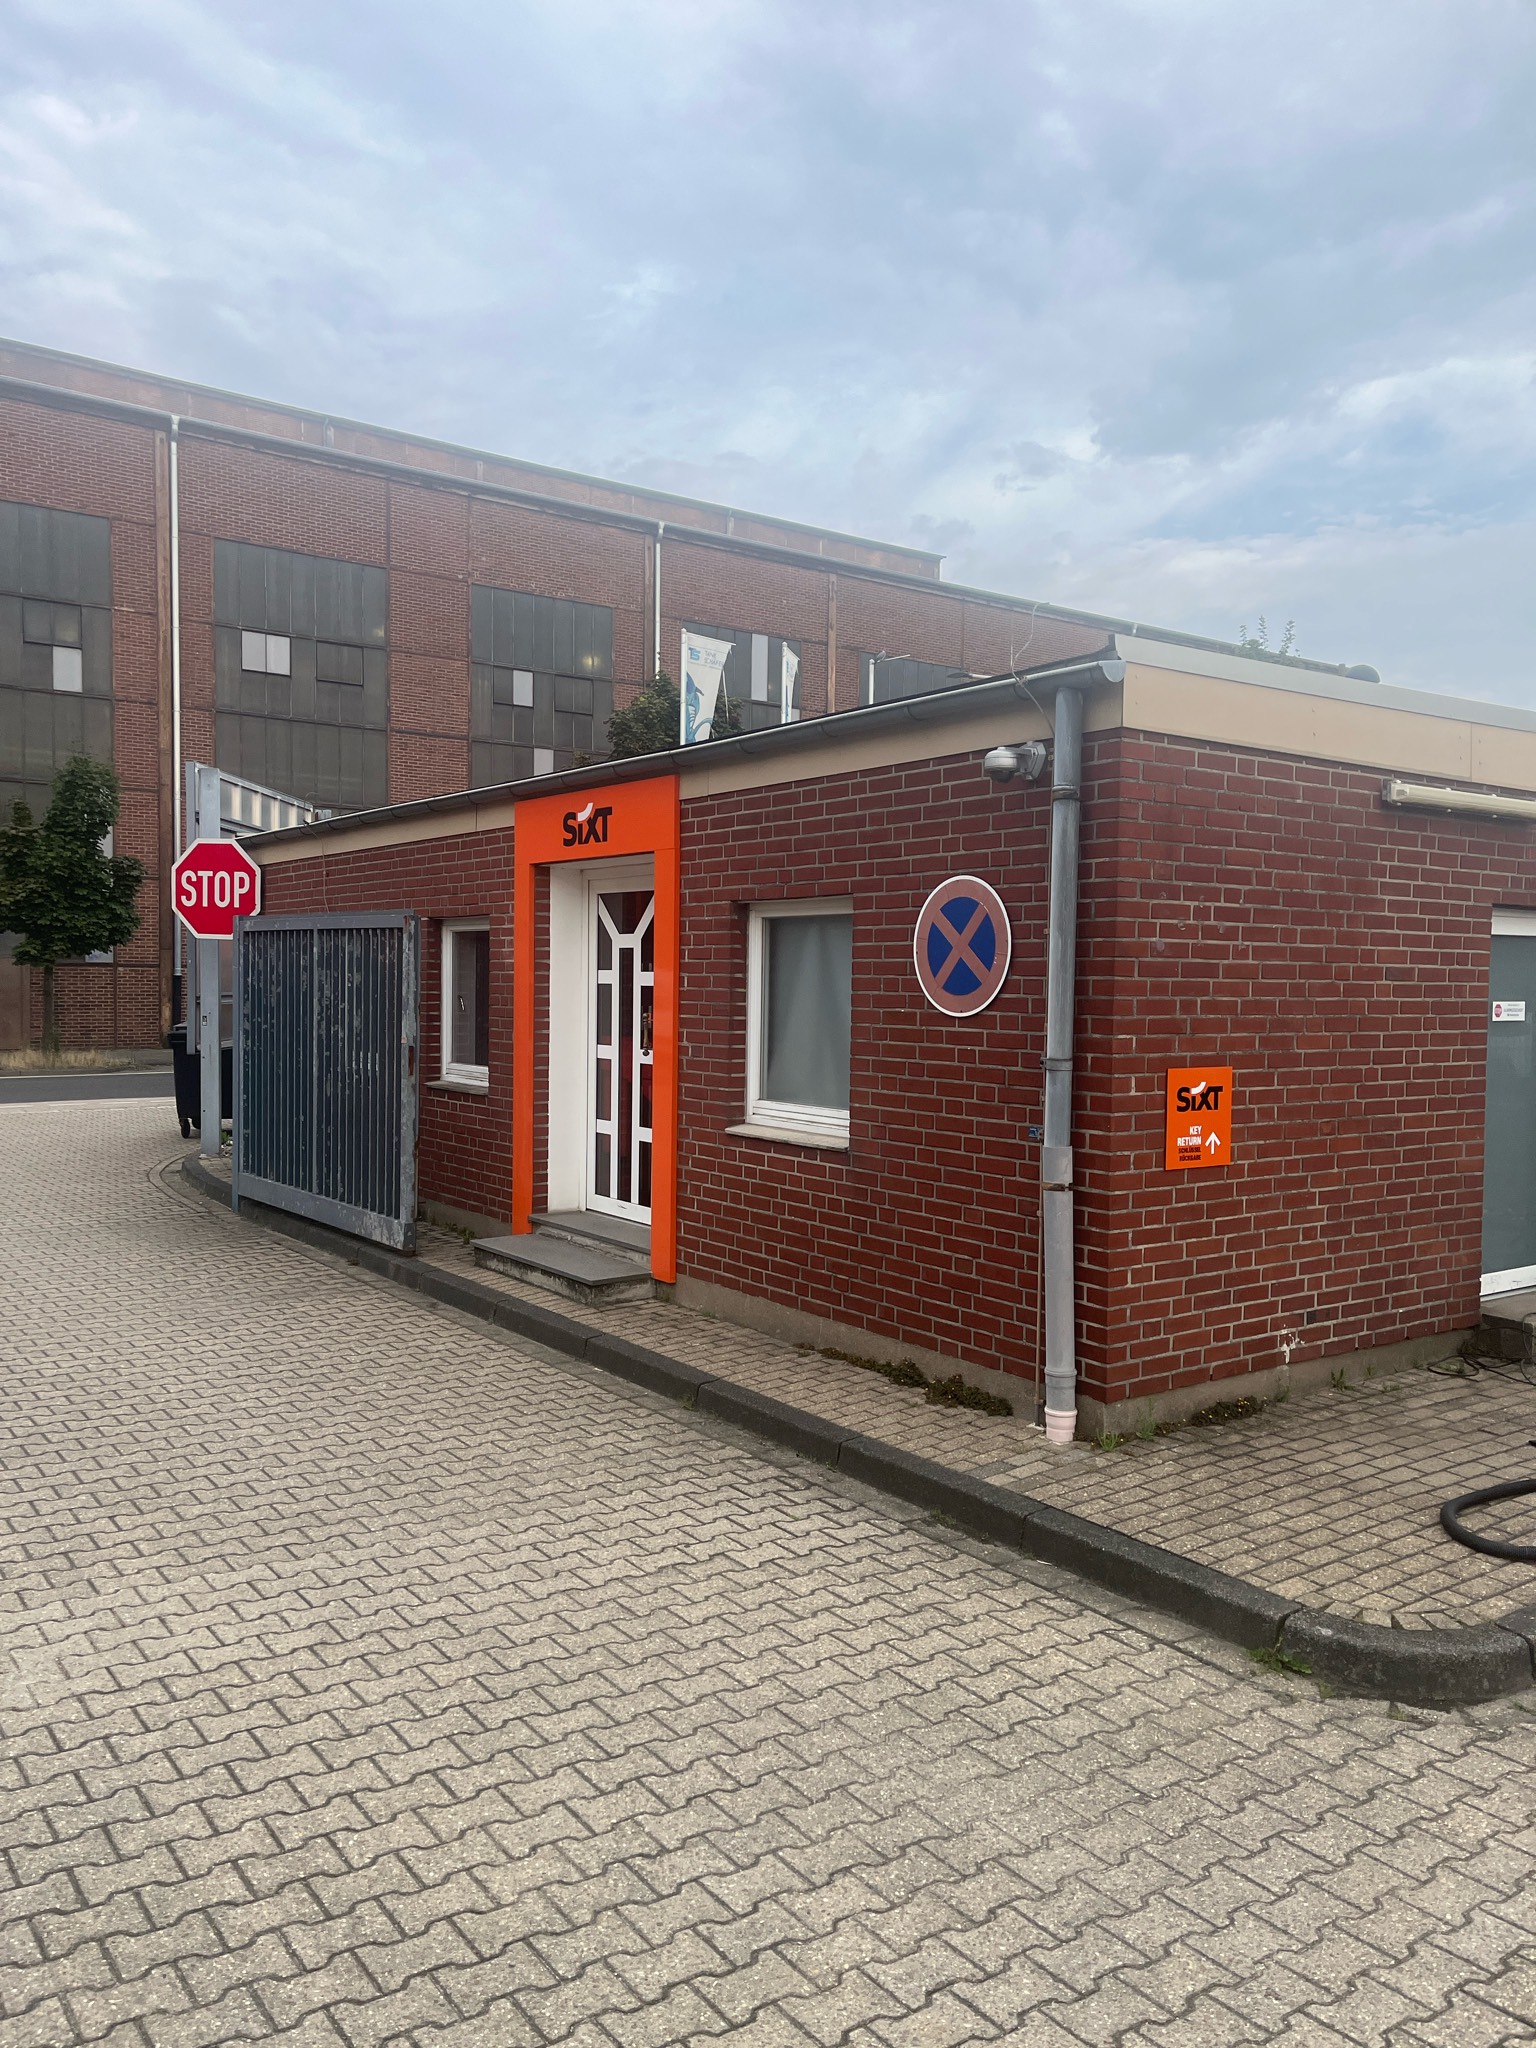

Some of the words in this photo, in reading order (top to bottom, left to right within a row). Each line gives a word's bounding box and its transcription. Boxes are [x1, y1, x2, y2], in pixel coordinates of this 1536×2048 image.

[181, 870, 250, 908] STOP
[1189, 1125, 1202, 1135] KEY
[1177, 1136, 1202, 1147] RETURN
